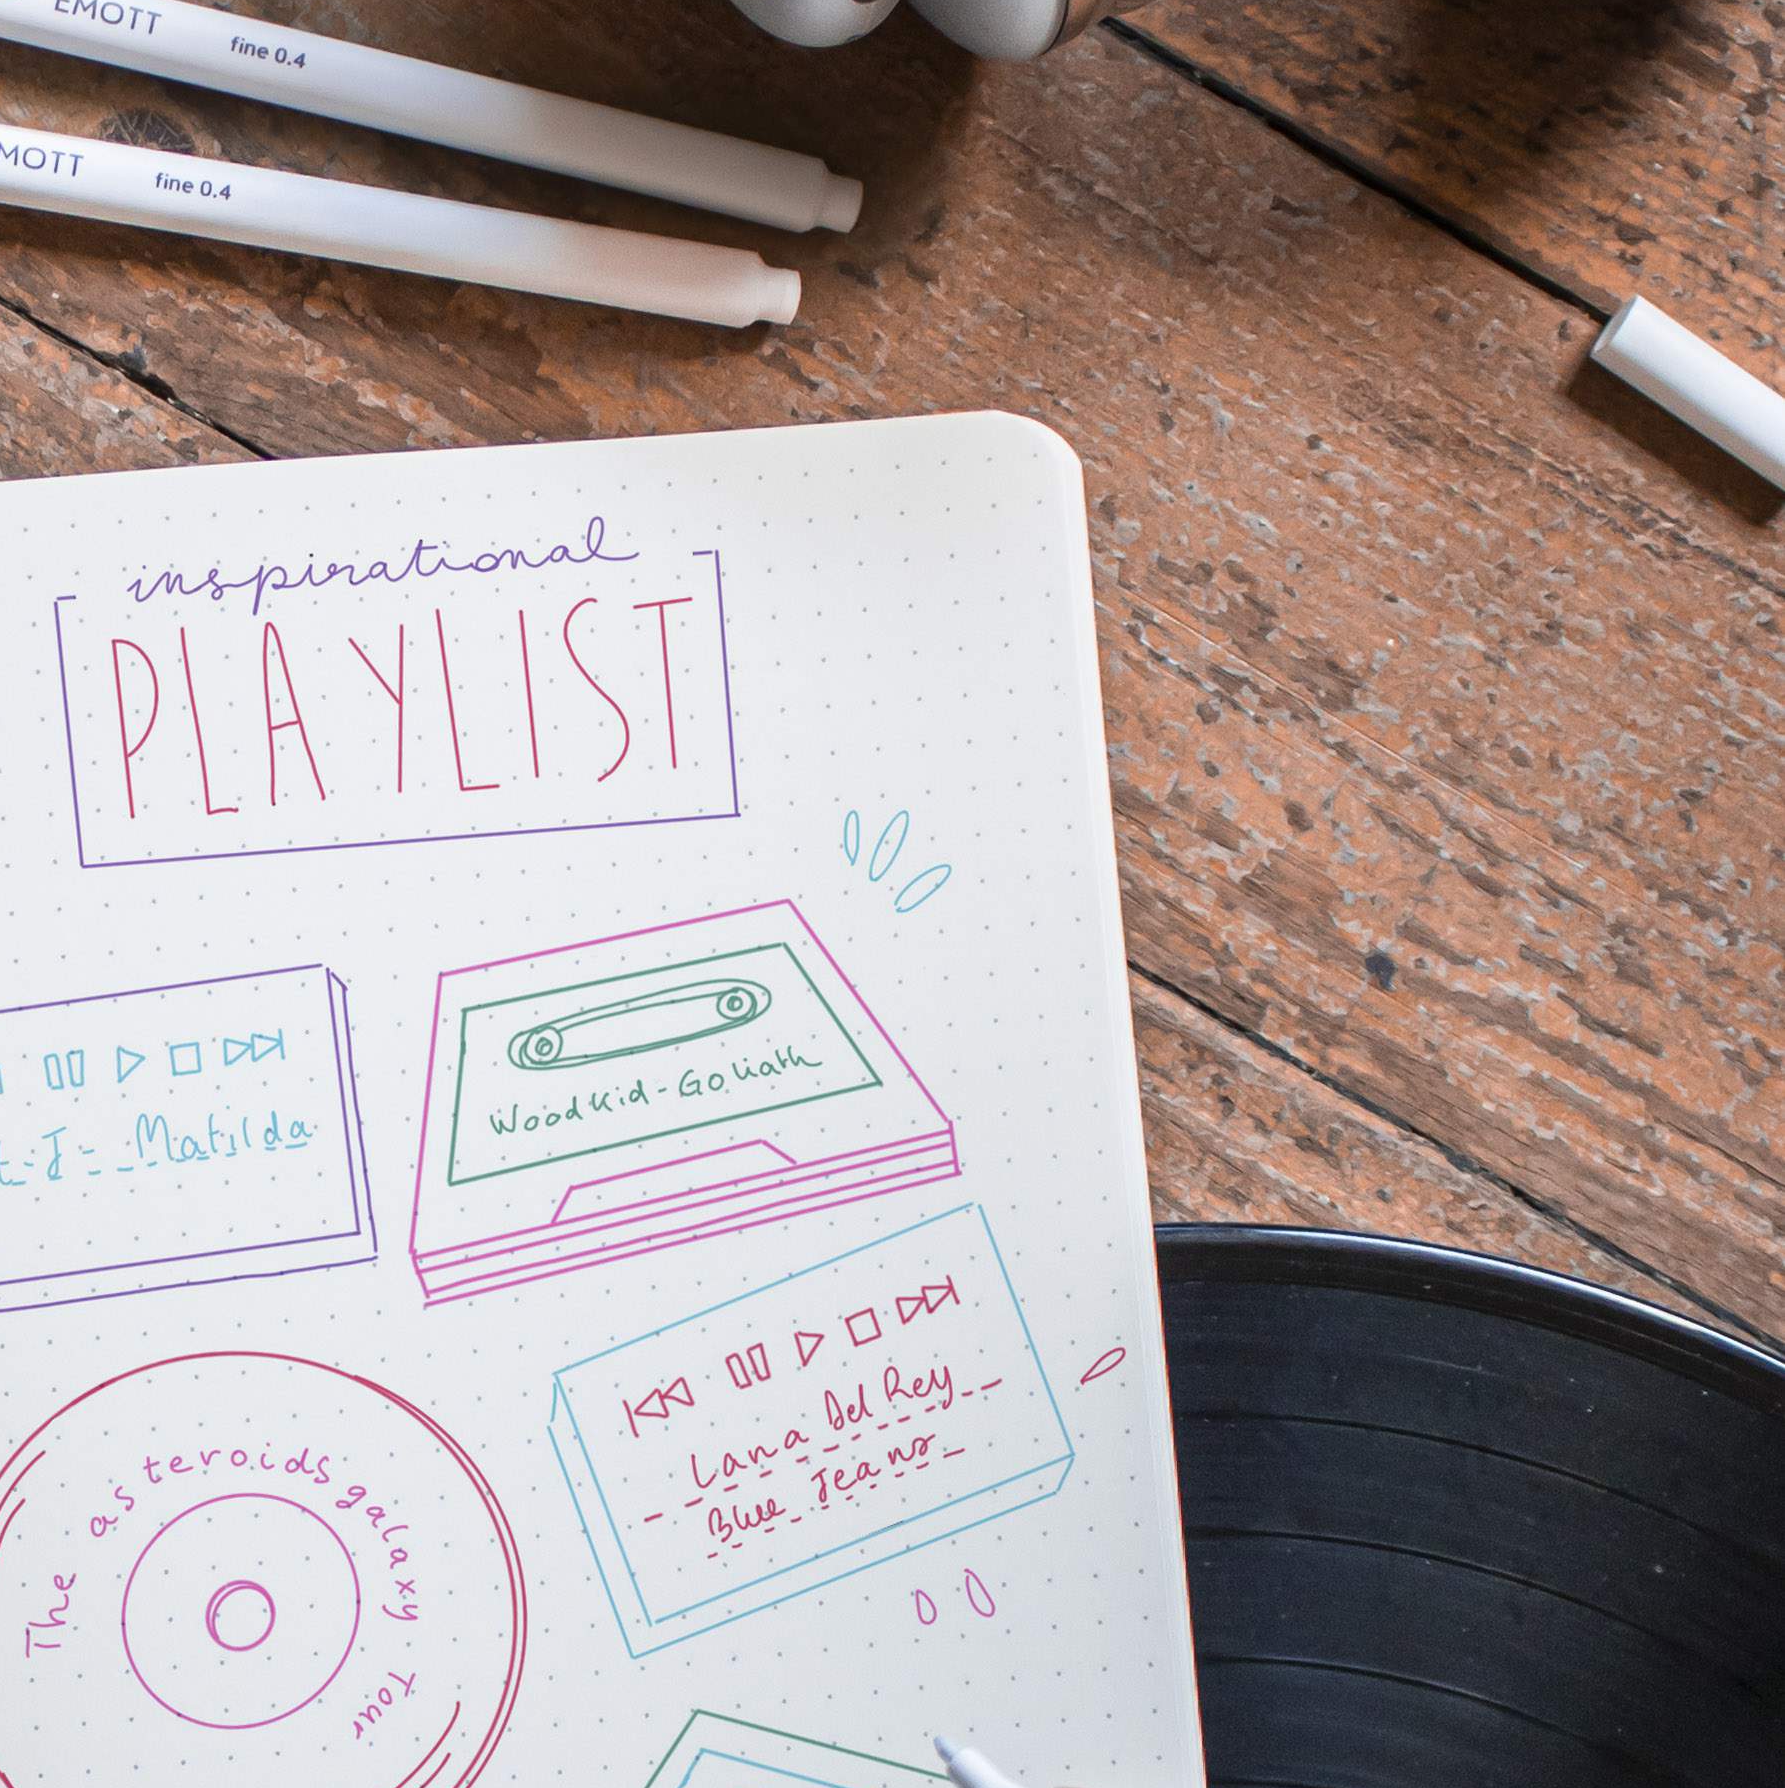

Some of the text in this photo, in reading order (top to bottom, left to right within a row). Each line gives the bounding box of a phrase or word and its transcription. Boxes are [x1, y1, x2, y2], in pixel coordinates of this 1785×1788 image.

[230, 36, 269, 60] fine
[275, 46, 307, 69] 0.4
[155, 172, 194, 194] fine
[200, 180, 232, 201] 0.4
[128, 516, 639, 616] inspirational
[111, 597, 693, 819] PLAYLIST
[691, 1365, 954, 1489] Lana Del Rey
[25, 1573, 77, 1658] The
[353, 1672, 417, 1740] Tour
